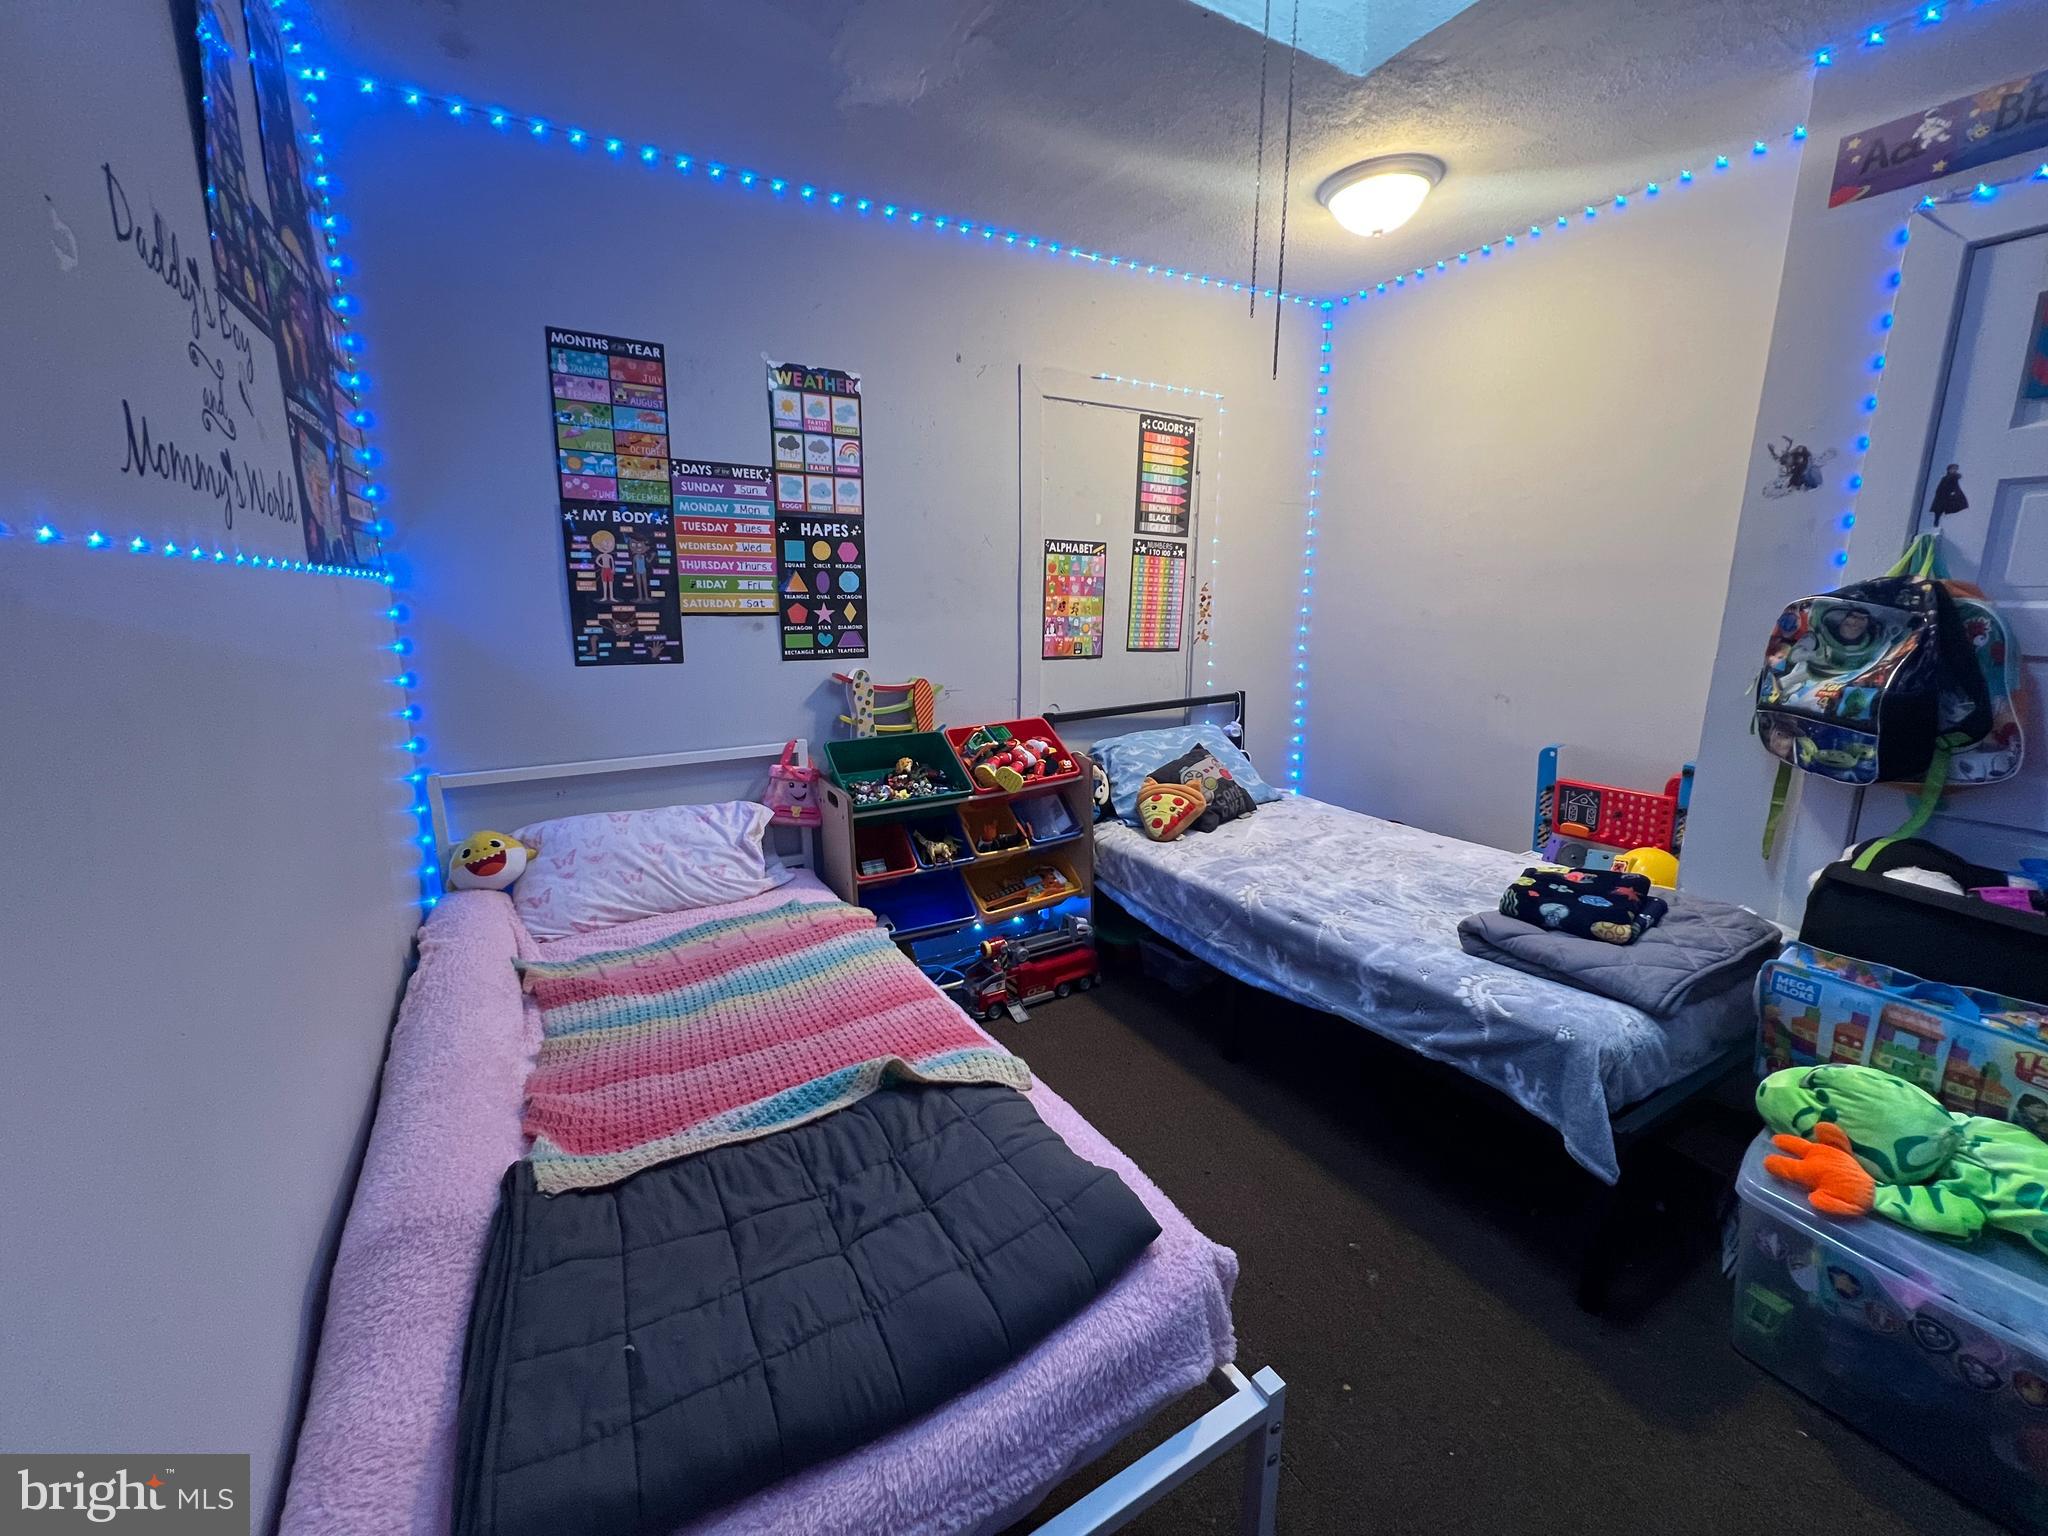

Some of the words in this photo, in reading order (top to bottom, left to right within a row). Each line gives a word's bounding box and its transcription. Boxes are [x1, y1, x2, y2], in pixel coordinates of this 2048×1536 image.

[101, 162, 216, 339] Daddy's
[216, 288, 253, 384] Boy
[551, 331, 609, 350] MONTHS
[626, 343, 660, 358] YEAR
[642, 374, 663, 384] JULY
[775, 371, 855, 394] WEATHER
[630, 397, 664, 409] AUGUST
[1151, 419, 1184, 435] COLORS
[630, 445, 667, 457] OCTOBER
[121, 399, 247, 530] Mommy's
[244, 461, 297, 524] World
[681, 463, 712, 476] DAYS
[731, 467, 764, 480] WEEK
[592, 489, 617, 499] JUNE
[681, 481, 725, 493] SUNDAY
[741, 485, 759, 495] Sun
[1149, 484, 1173, 494] PURPLE
[626, 491, 669, 504] DECEMBER
[679, 501, 729, 513] MONDAY
[739, 505, 761, 515] Mon
[781, 502, 802, 510] FOGGY
[1148, 504, 1172, 513] BROWN
[582, 509, 607, 522] MY
[612, 510, 654, 524] BODY
[1148, 513, 1170, 523] BLACK
[681, 521, 729, 533] TUESDAY
[741, 524, 762, 533] Tues
[800, 522, 849, 538] HAPES
[678, 541, 734, 551] WEDNESDAY
[742, 543, 762, 553] Wed
[1049, 542, 1093, 554] ALPHABET
[680, 559, 735, 570] THURSDAY
[739, 561, 768, 571] Thurs
[747, 580, 761, 589] Fri
[682, 598, 737, 608] SATURDAY
[747, 599, 766, 608] Sat
[1777, 975, 1817, 995] MEGA
[1776, 983, 1814, 1002] BLOKS
